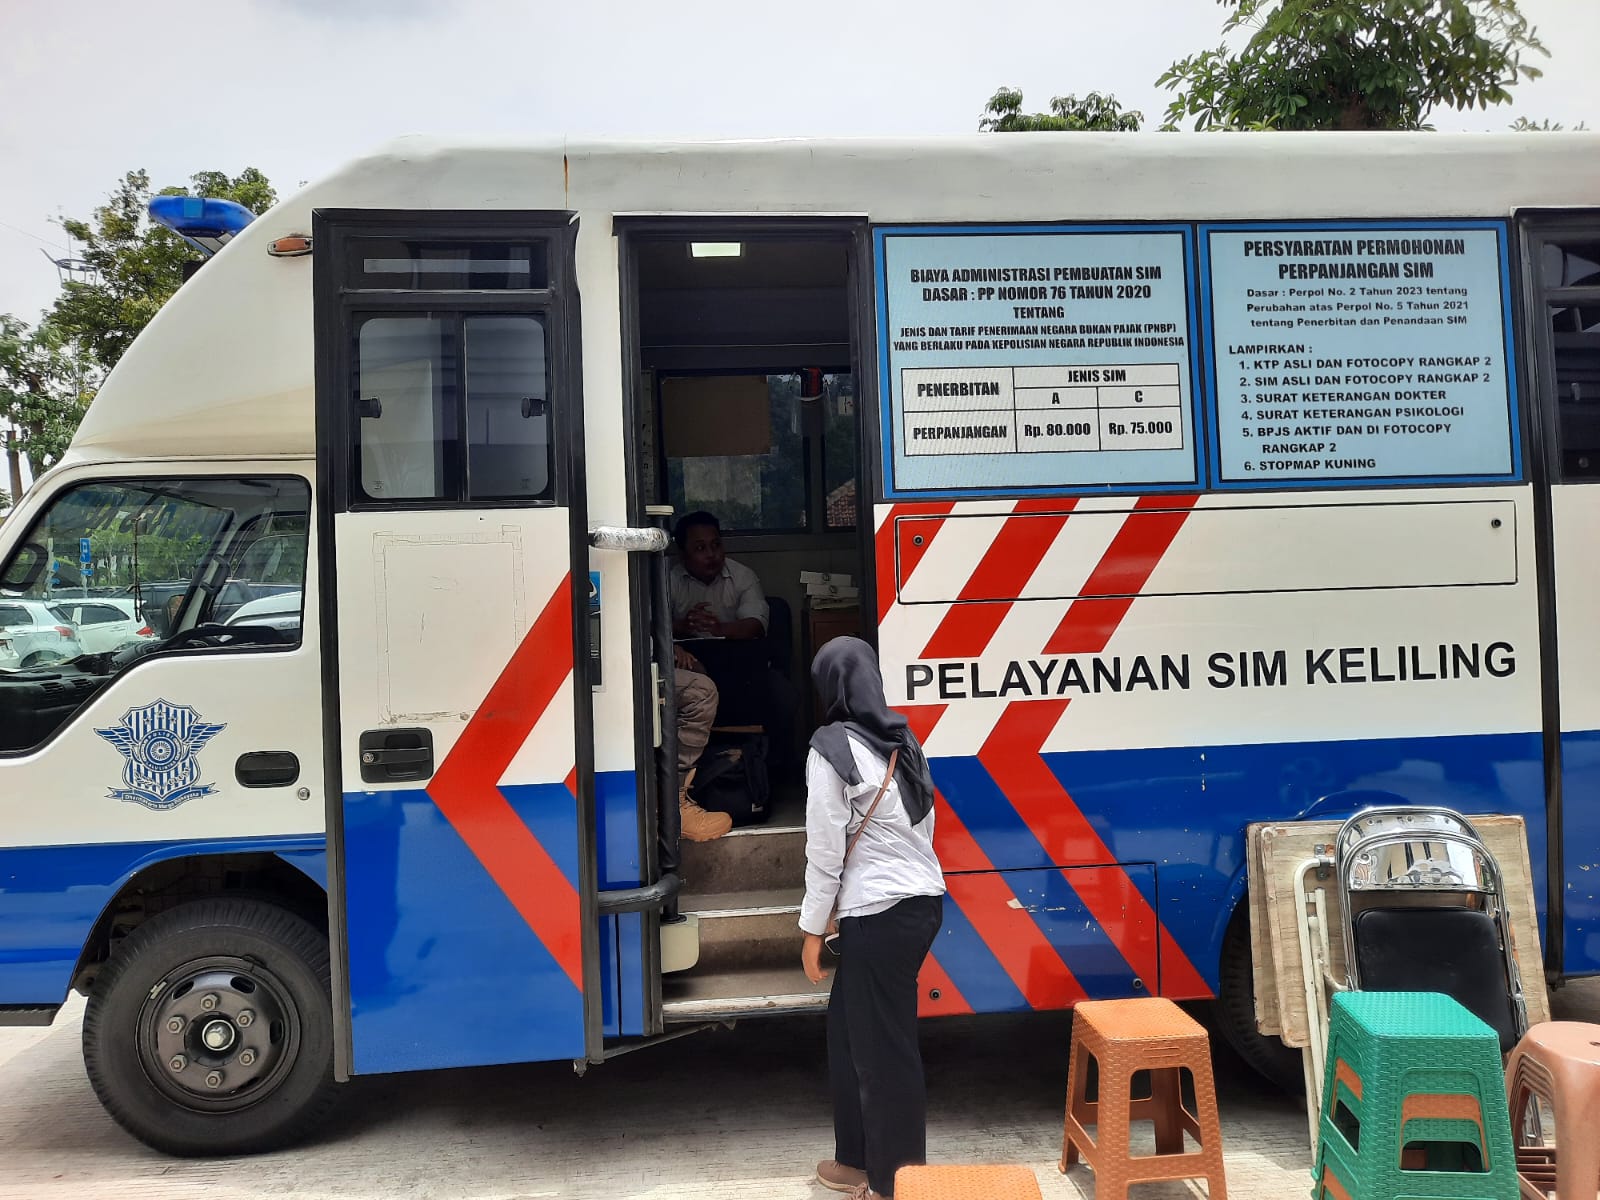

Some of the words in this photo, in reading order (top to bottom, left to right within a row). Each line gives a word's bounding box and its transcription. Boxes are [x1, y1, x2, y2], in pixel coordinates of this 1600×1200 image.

[1244, 240, 1353, 256] PERSYARATAN
[1357, 239, 1465, 255] PERMOHONAN
[910, 268, 949, 283] BIAYA
[952, 267, 1050, 282] ADMINISTRASI
[1054, 266, 1133, 281] PEMBUATAN
[1136, 266, 1162, 280] SIM
[1279, 263, 1400, 279] PERPANJANGAN
[1404, 262, 1433, 277] SIM
[922, 288, 968, 301] DASAR
[978, 288, 995, 300] PP
[998, 287, 1047, 300] NOMOR
[1050, 286, 1066, 299] 76
[1070, 286, 1113, 299] TAHUN
[1117, 285, 1151, 298] 2020
[1247, 288, 1279, 297] Dasar
[1289, 287, 1324, 298] Perpol
[1328, 287, 1346, 296] No.
[1350, 287, 1355, 295] 2
[1359, 287, 1393, 296] Tahun
[1396, 287, 1422, 295] 2023
[1426, 286, 1468, 297] tentang
[1013, 306, 1065, 319] TENTANG
[1247, 302, 1306, 312] Perubahan
[1310, 303, 1333, 311] atas
[1336, 301, 1372, 312] Perpol
[1375, 301, 1394, 310] No.
[1397, 301, 1403, 309] 5
[1407, 301, 1440, 309] Tahun
[1443, 301, 1468, 309] 2021
[1251, 318, 1294, 328] tentang
[1297, 317, 1356, 326] Penerbitan
[1360, 316, 1380, 325] dan
[1383, 316, 1443, 325] Penandaan
[1447, 315, 1467, 324] SIM
[900, 327, 926, 337] JENIS
[928, 326, 947, 337] DAN
[950, 326, 976, 336] TARIF
[978, 325, 1038, 336] PENERIMAAN
[1040, 325, 1078, 335] NEGARA
[1079, 324, 1112, 334] BUKAN
[1114, 324, 1143, 334] PAJAK
[1145, 323, 1177, 333] (PNBP)
[894, 341, 918, 351] YANG
[921, 340, 963, 351] BERLAKU
[965, 340, 989, 350] PADA
[992, 339, 1047, 349] KEPOLISIAN
[1049, 338, 1085, 348] NEGARA
[1088, 337, 1132, 348] REPUBLIK
[1135, 337, 1184, 347] INDONESIA
[1229, 344, 1305, 354] LAMPIRKAN
[1239, 360, 1250, 369] 1.
[1254, 360, 1280, 369] KTP
[1283, 359, 1312, 369] ASLI
[1316, 359, 1342, 368] DAN
[1346, 358, 1415, 368] FOTOCOPY
[1419, 357, 1480, 367] RANGKAP
[1484, 357, 1492, 366] 2
[1067, 370, 1099, 382] JENIS
[1103, 370, 1126, 382] SIM
[1240, 377, 1251, 386] 2.
[1255, 377, 1278, 386] SIM
[1282, 376, 1310, 385] ASLI
[1314, 376, 1341, 385] DAN
[1345, 374, 1413, 384] FOTOCOPY
[1417, 374, 1479, 383] RANGKAP
[1483, 374, 1490, 382] 2
[917, 382, 999, 397] PENERBITAN
[1052, 393, 1060, 404] A
[1135, 391, 1143, 403] C
[1240, 394, 1252, 403] 3.
[1256, 393, 1298, 403] SURAT
[1302, 392, 1390, 402] KETERANGAN
[1394, 391, 1446, 400] DOKTER
[1241, 411, 1252, 420] 4.
[1256, 410, 1299, 419] SURAT
[1303, 408, 1392, 418] KETERANGAN
[1395, 407, 1464, 417] PSIKOLOGI
[913, 425, 1007, 439] PERPANJANGAN
[1024, 424, 1044, 438] Rp.
[1046, 423, 1091, 436] 80.000
[1108, 422, 1128, 436] Rp.
[1130, 421, 1172, 434] 75.000
[1242, 428, 1253, 437] 5.
[1257, 427, 1290, 437] BPJS
[1294, 426, 1333, 435] AKTIF
[1336, 425, 1362, 435] DAN
[1367, 425, 1379, 434] DI
[1384, 424, 1452, 434] FOTOCOPY
[1262, 443, 1325, 453] RANGKAP
[1329, 443, 1336, 452] 2
[1244, 461, 1255, 471] 6.
[1259, 460, 1321, 470] STOPMAP
[1325, 459, 1376, 468] KUNING
[906, 654, 1190, 700] PELAYANAN
[1207, 651, 1287, 688] SIM
[1305, 642, 1516, 684] KELILING
